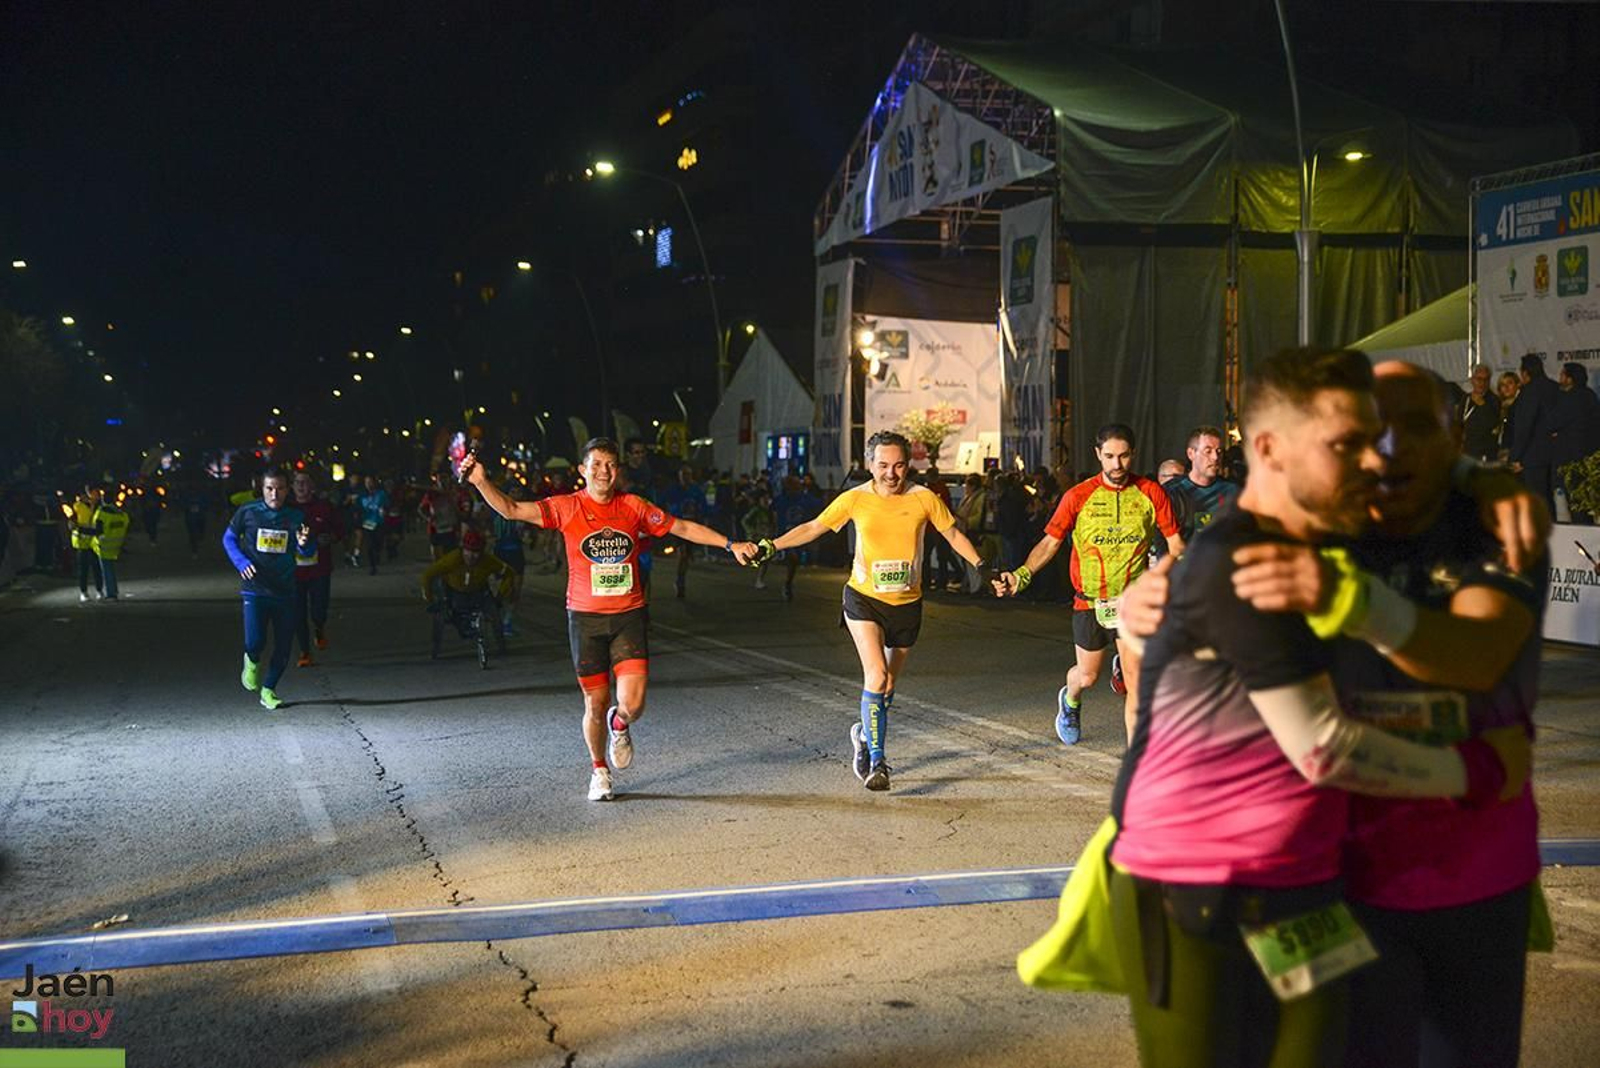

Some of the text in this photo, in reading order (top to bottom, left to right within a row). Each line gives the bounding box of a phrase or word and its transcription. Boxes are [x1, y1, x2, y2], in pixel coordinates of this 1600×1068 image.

[1496, 203, 1515, 240] 41
[589, 537, 629, 547] Estrella
[590, 547, 626, 557] Galicia
[880, 571, 905, 582] 2607
